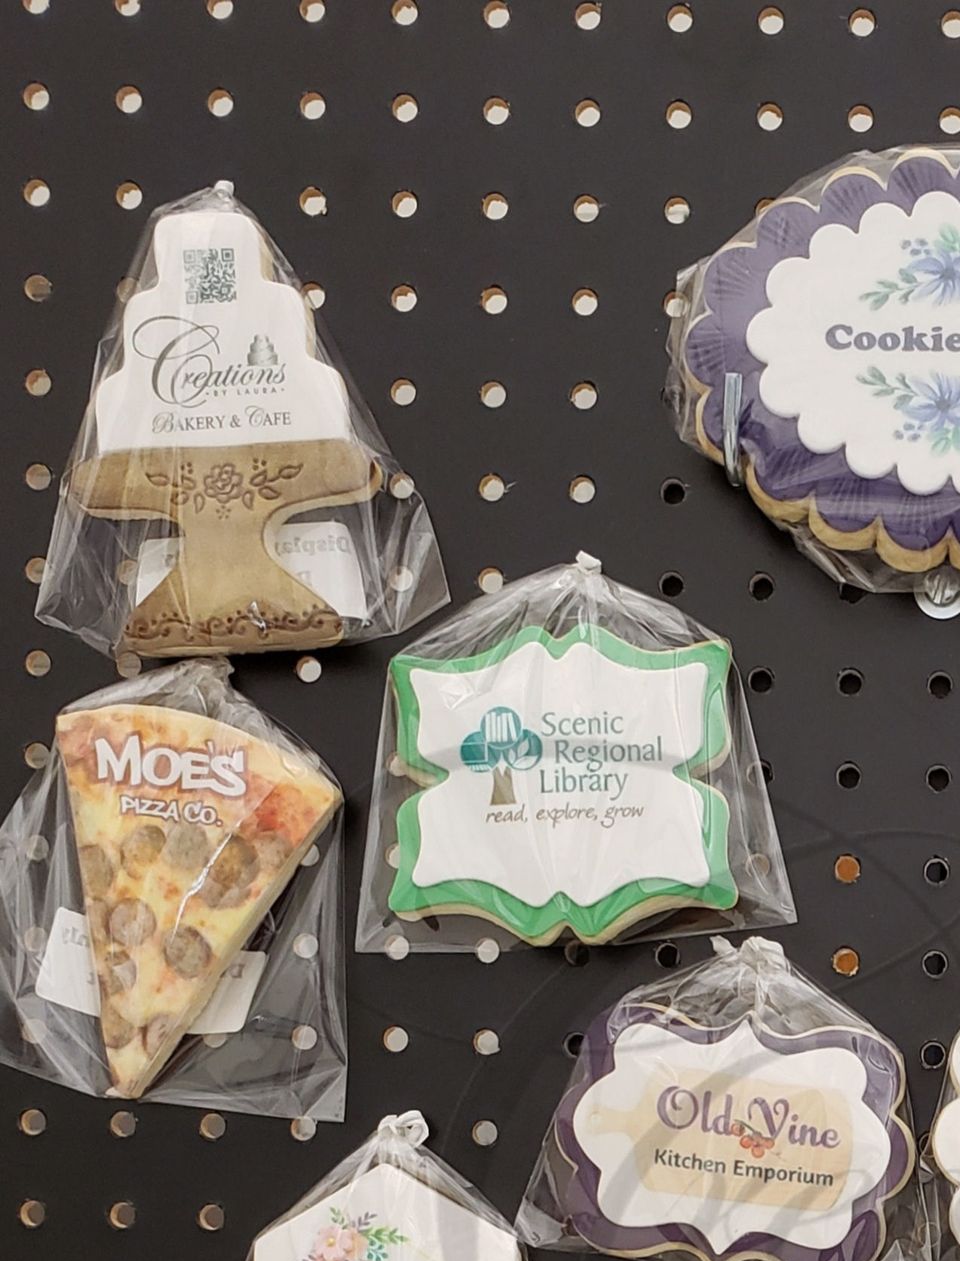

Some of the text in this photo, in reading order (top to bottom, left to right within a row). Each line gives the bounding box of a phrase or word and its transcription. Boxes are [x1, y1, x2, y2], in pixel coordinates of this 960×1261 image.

[132, 315, 287, 409] Creations
[151, 405, 292, 434] BAKERY & CAFE
[540, 711, 624, 737] Scenic
[554, 735, 663, 772] Regional
[539, 766, 628, 801] Library
[120, 795, 180, 822] PIZZA
[485, 801, 645, 829] read, explore, grow
[656, 1085, 841, 1148] Old Vine
[653, 1148, 834, 1187] Kitchen Emporium
